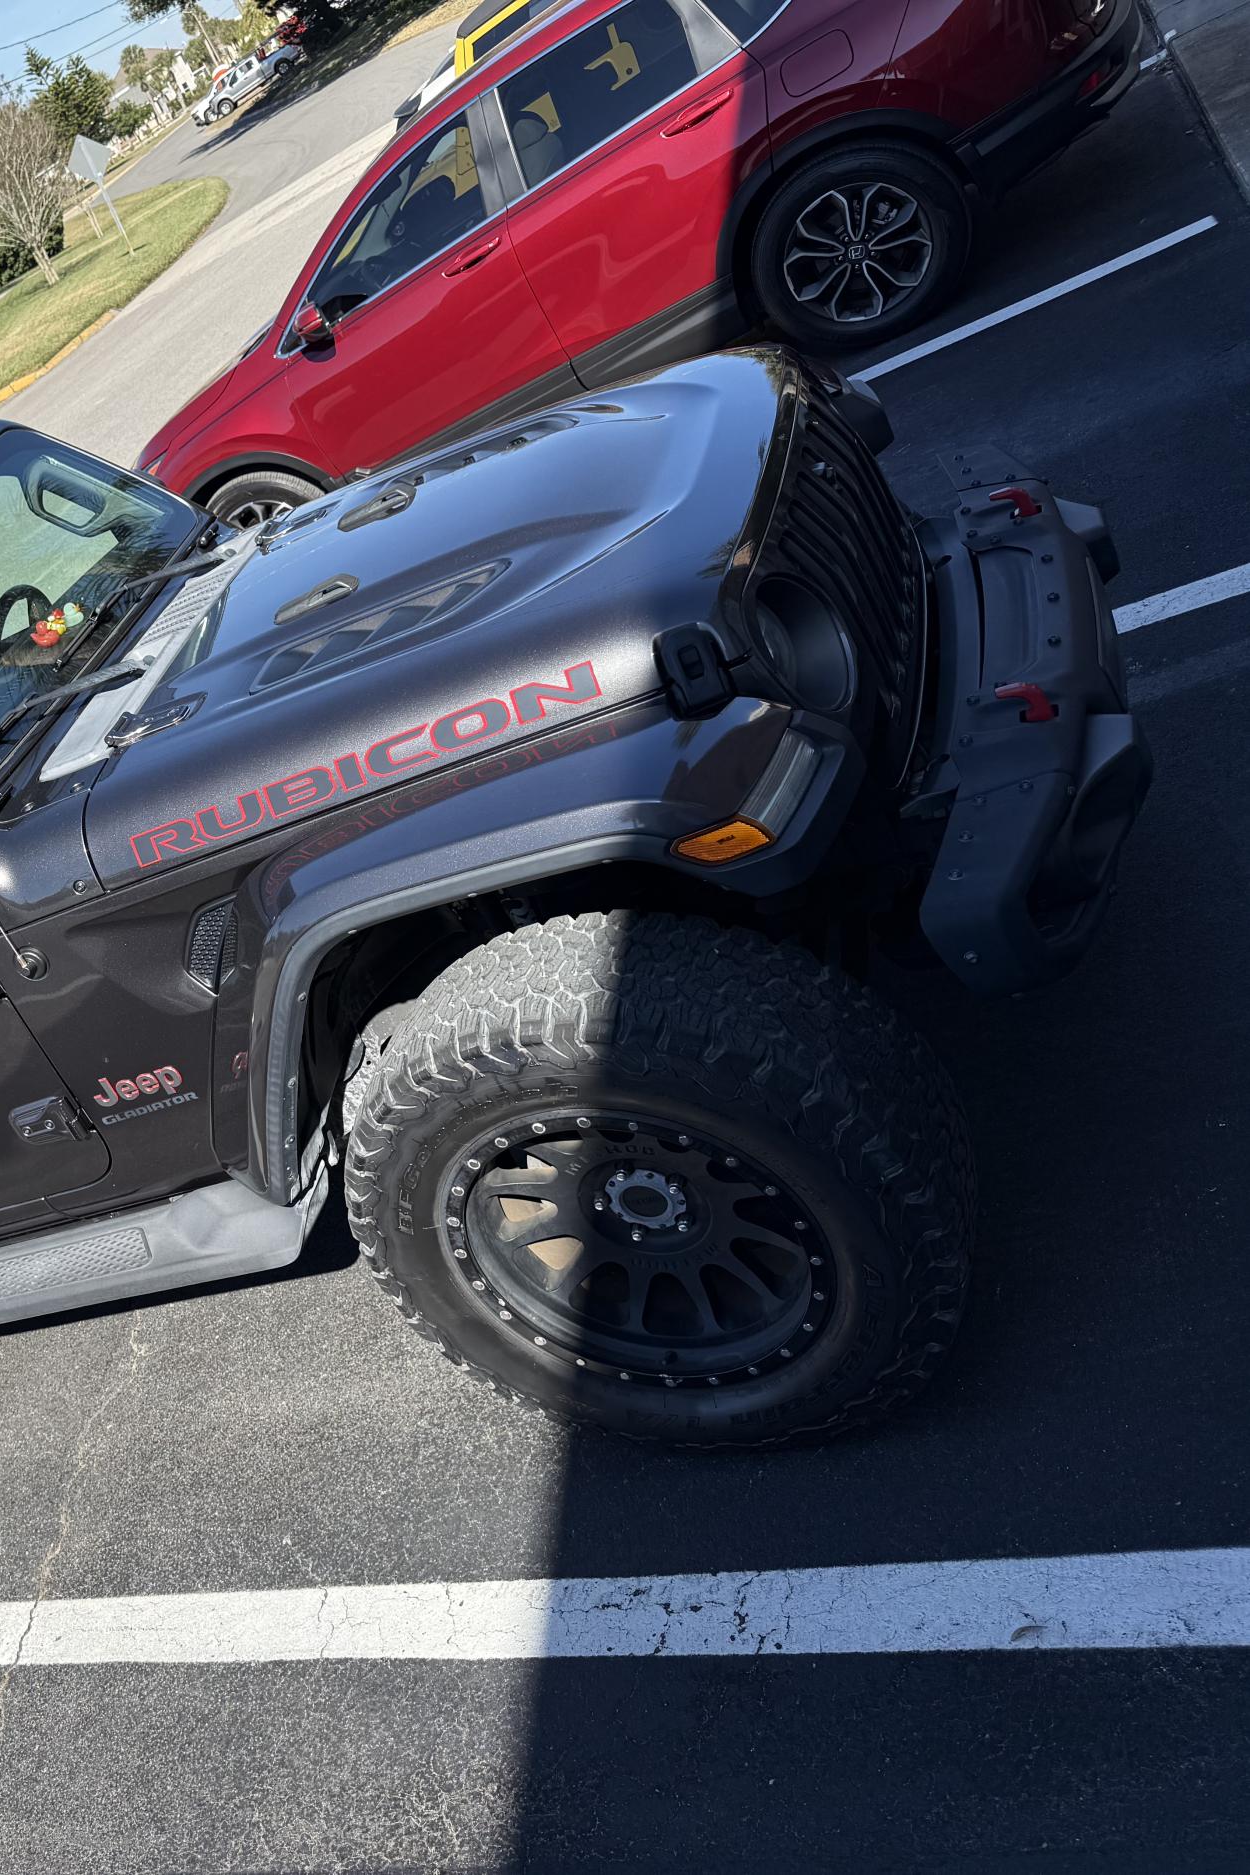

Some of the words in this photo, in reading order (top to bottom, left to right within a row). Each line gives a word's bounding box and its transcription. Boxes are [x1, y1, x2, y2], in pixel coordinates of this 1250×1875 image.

[131, 660, 602, 868] RUBICON
[94, 1065, 183, 1107] Jeep
[102, 1092, 199, 1126] GLADIATOR
